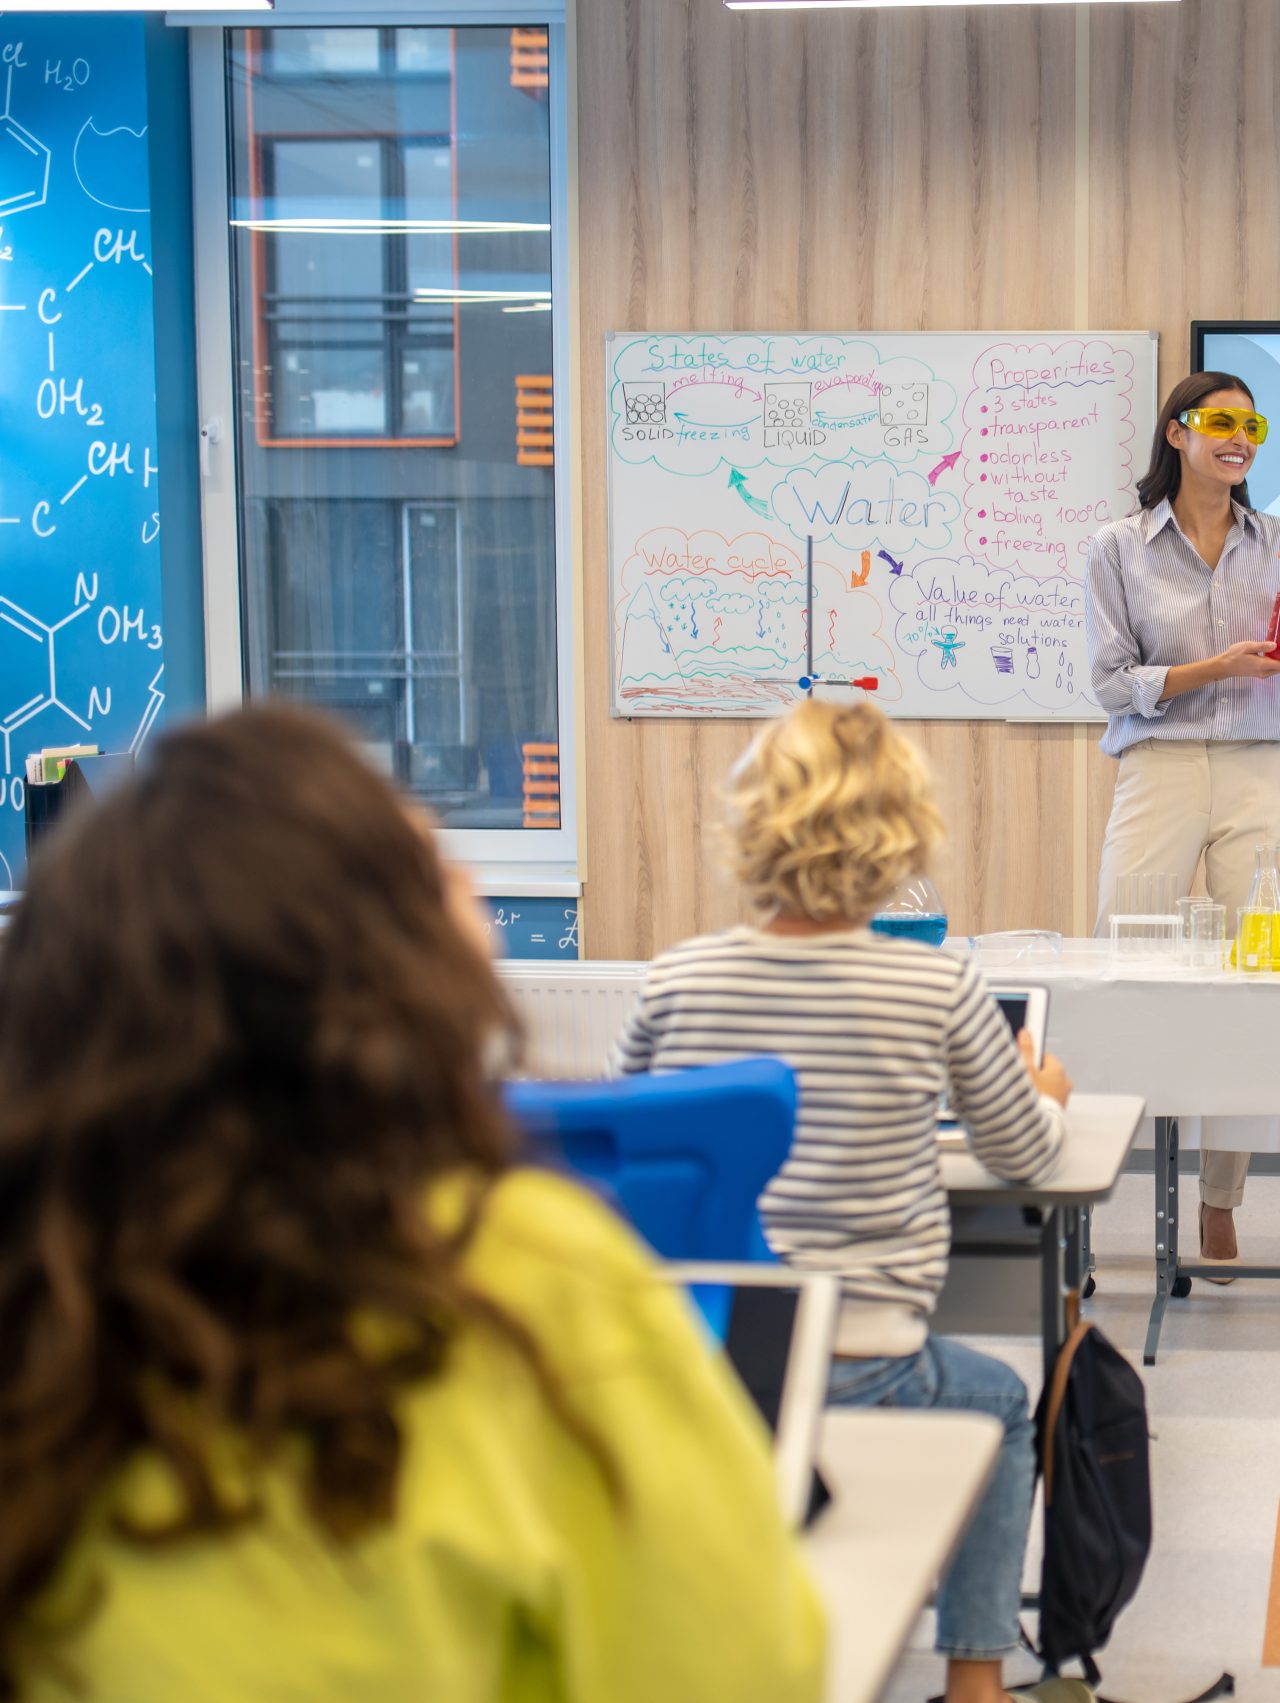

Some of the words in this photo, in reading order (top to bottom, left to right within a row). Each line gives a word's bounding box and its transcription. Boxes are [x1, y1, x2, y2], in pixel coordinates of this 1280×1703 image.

[45, 58, 90, 91] H2O
[0, 226, 13, 261] 2
[94, 228, 145, 264] CH
[38, 288, 62, 324] C
[649, 344, 729, 369] States
[745, 342, 776, 375] of
[791, 345, 847, 369] water
[990, 352, 1115, 394] Properities
[672, 366, 744, 398] melting
[994, 396, 1004, 414] 3
[1011, 389, 1057, 411] states
[675, 427, 751, 447] freezing
[883, 426, 930, 447] GAS
[989, 402, 1099, 448] transparent
[88, 441, 134, 477] CH
[989, 441, 1072, 465] odorless
[990, 461, 1068, 485] without
[792, 476, 946, 528] Water
[1004, 484, 1058, 502] taste
[32, 500, 57, 538] C
[992, 502, 1043, 536] boling
[641, 542, 715, 571] Water
[727, 541, 795, 584] cycle
[991, 530, 1067, 569] freezing
[74, 572, 98, 606] N
[916, 575, 978, 603] Value
[985, 581, 1011, 612] of
[1016, 584, 1080, 609] water
[915, 605, 937, 622] all
[944, 606, 993, 632] things
[1003, 614, 1029, 627] need
[1040, 614, 1084, 628] water
[999, 627, 1068, 648] solutions
[88, 686, 111, 719] N
